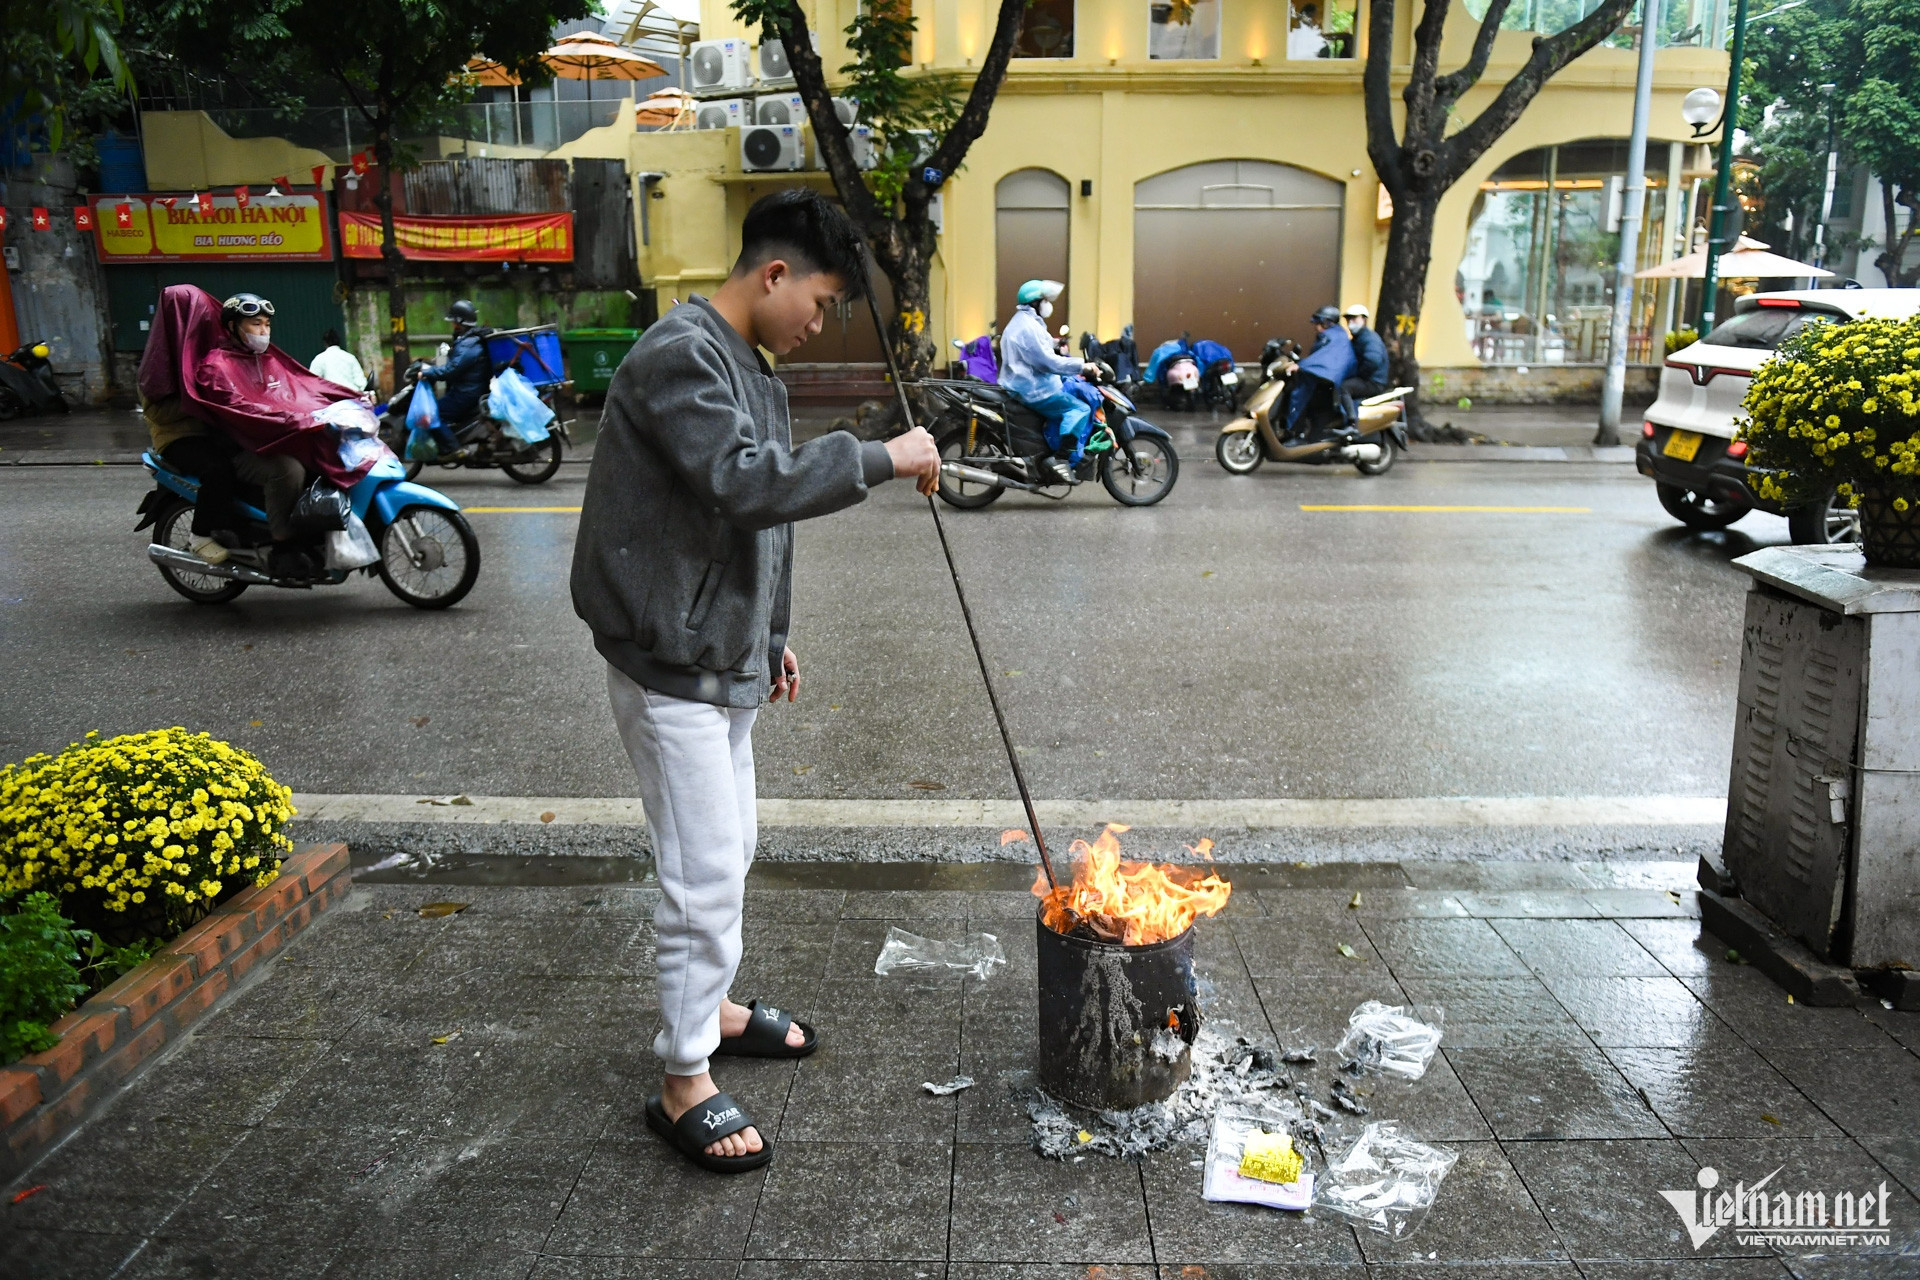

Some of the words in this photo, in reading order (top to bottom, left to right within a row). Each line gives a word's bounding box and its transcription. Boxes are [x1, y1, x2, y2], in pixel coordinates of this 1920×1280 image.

[168, 207, 199, 224] BIA
[241, 202, 272, 224] HÀ
[271, 203, 307, 227] NỘI
[107, 229, 144, 237] HABECO
[194, 236, 214, 246] BIA
[260, 232, 283, 246] BÉO
[713, 1107, 740, 1123] STAR
